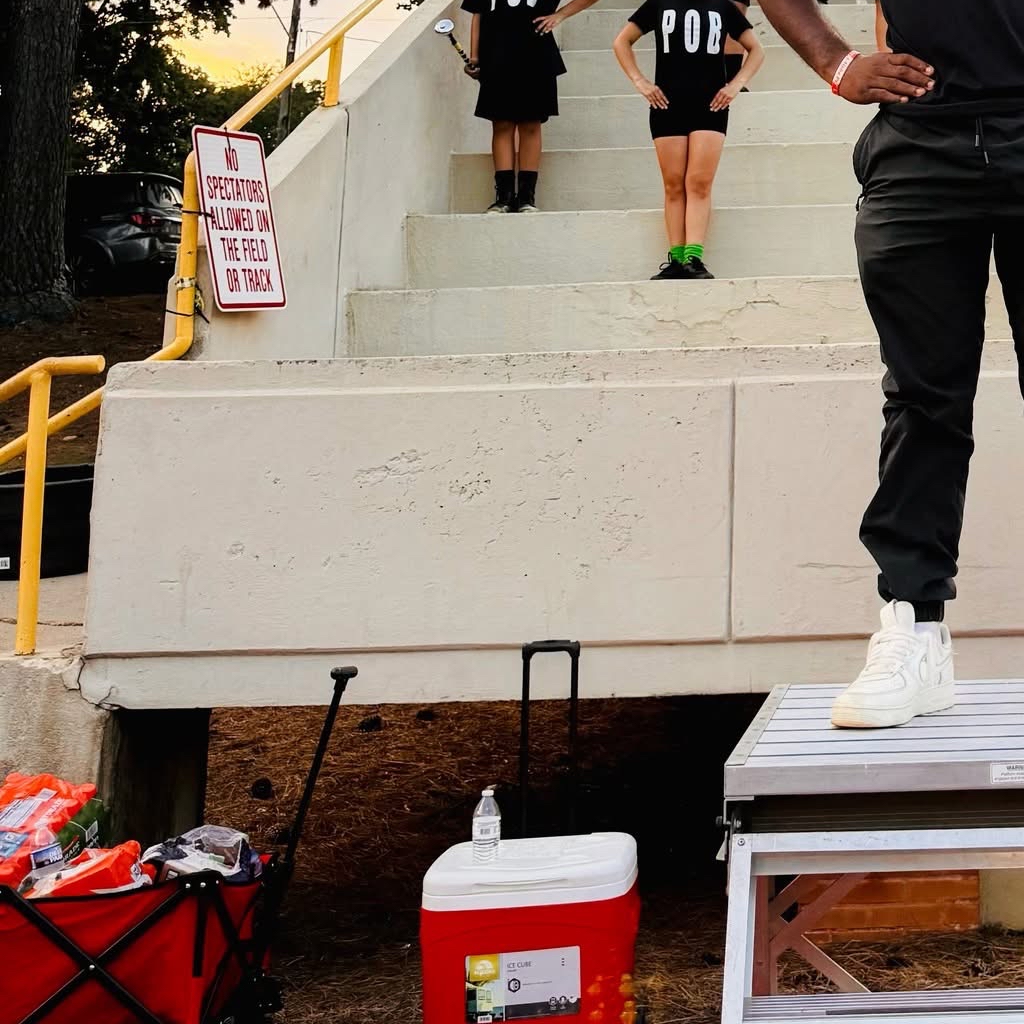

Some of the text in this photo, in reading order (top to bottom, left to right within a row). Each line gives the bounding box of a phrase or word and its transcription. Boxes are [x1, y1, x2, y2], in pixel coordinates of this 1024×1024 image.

[661, 8, 722, 55] POB
[225, 147, 239, 171] NO
[206, 175, 265, 204] SPECTATORS
[211, 206, 270, 233] ALLOWED ON
[220, 237, 268, 263] THE FIELD
[226, 268, 274, 293] OR TRACK
